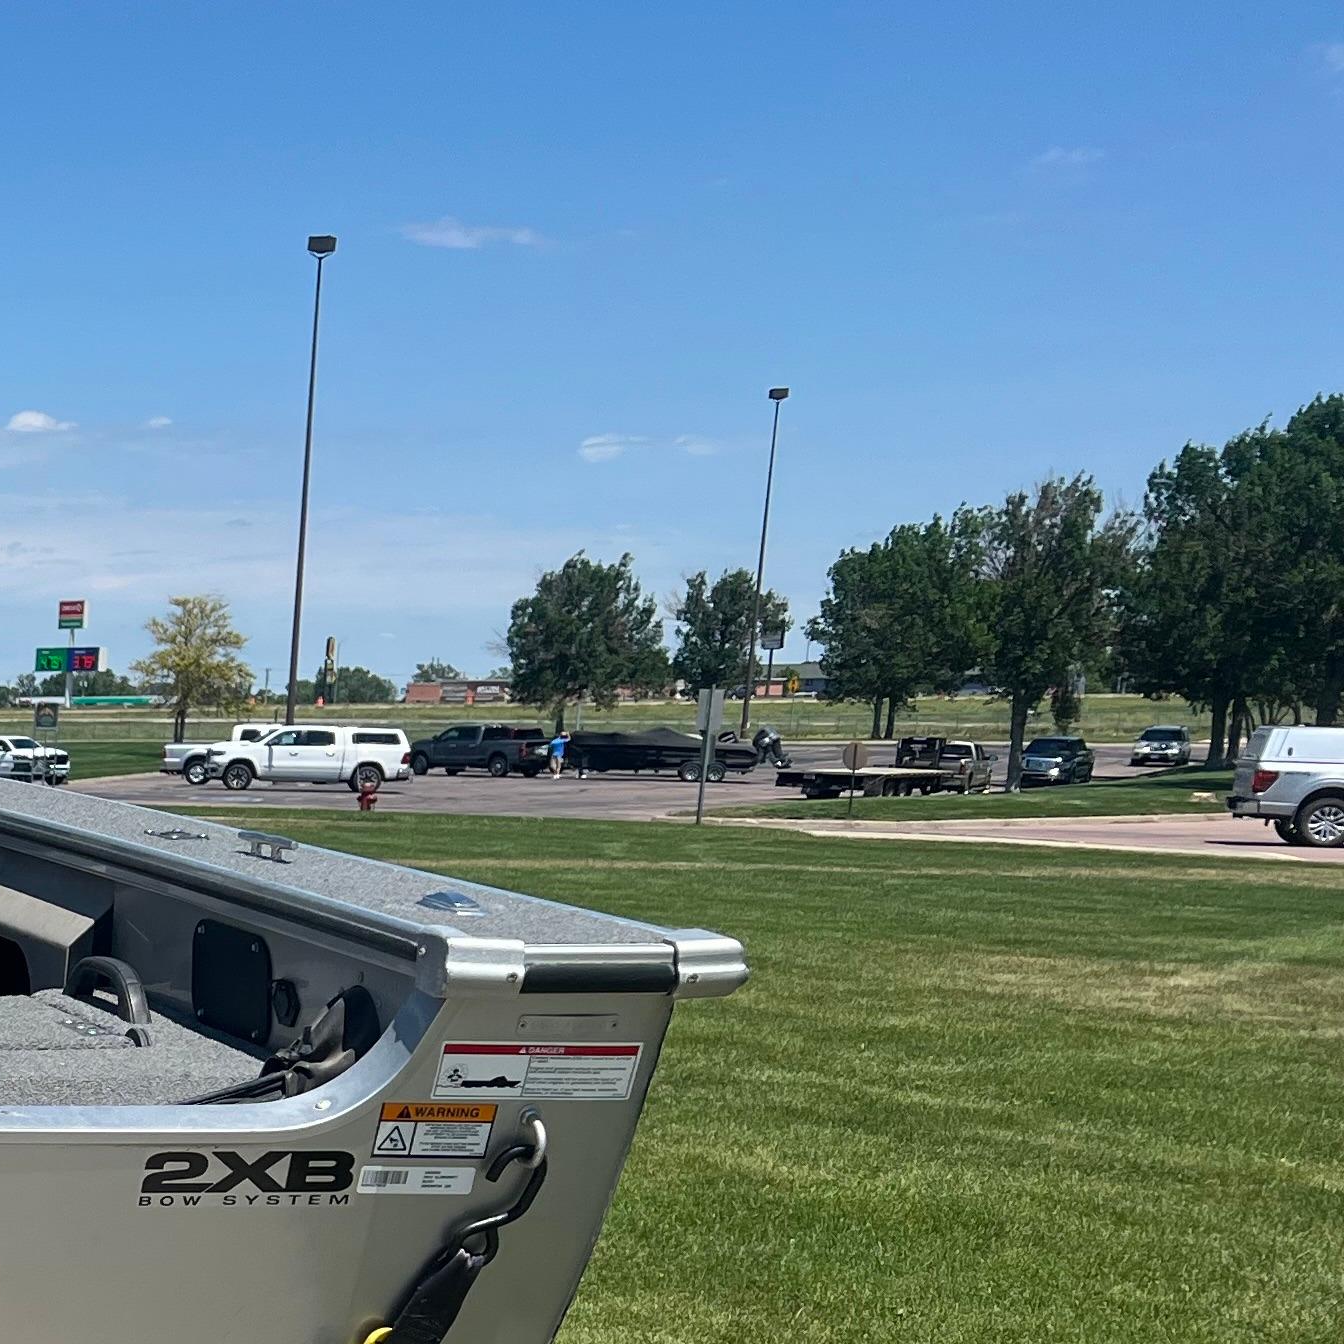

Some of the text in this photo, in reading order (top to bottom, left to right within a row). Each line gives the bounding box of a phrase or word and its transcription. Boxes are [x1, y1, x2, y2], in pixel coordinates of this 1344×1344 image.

[527, 1046, 565, 1054] DANGER
[415, 1106, 480, 1118] WARNING
[140, 1150, 356, 1194] 2XB
[138, 1194, 351, 1207] BOW SYSTEM
